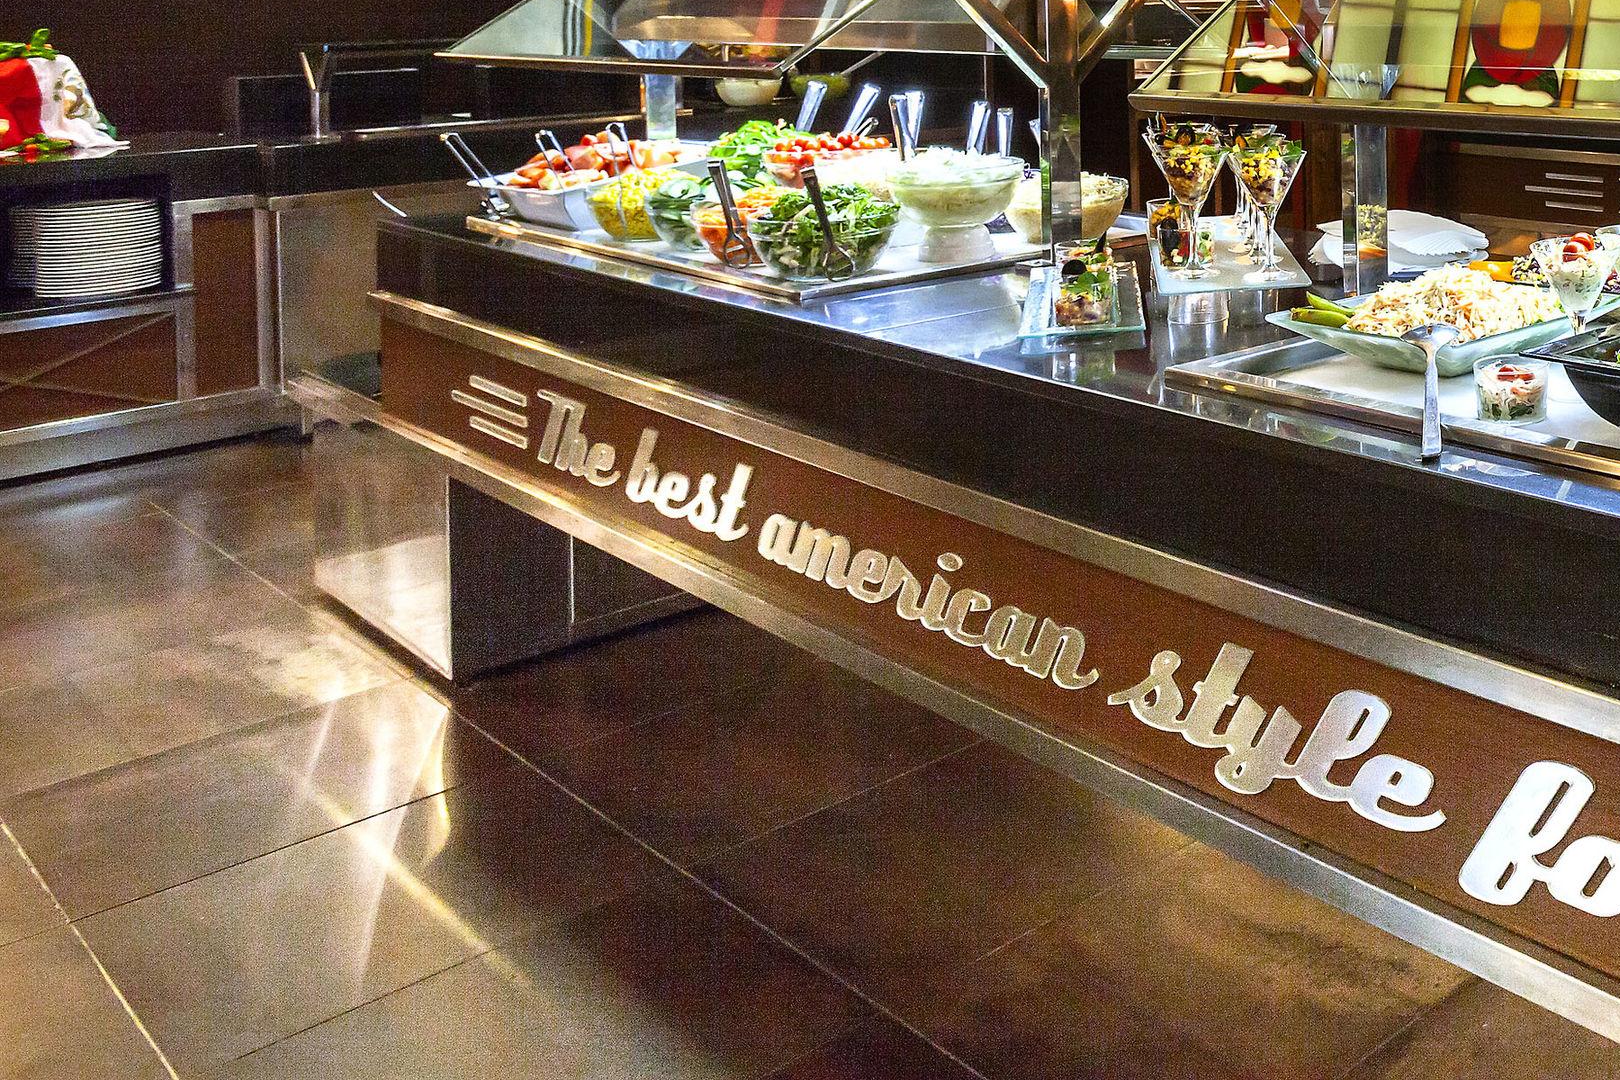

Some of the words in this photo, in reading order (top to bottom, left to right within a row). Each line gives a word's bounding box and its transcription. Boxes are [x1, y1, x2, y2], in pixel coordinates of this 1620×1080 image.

[537, 389, 620, 487] The
[626, 427, 752, 542] best
[758, 512, 1100, 690] american
[1108, 641, 1447, 832] style
